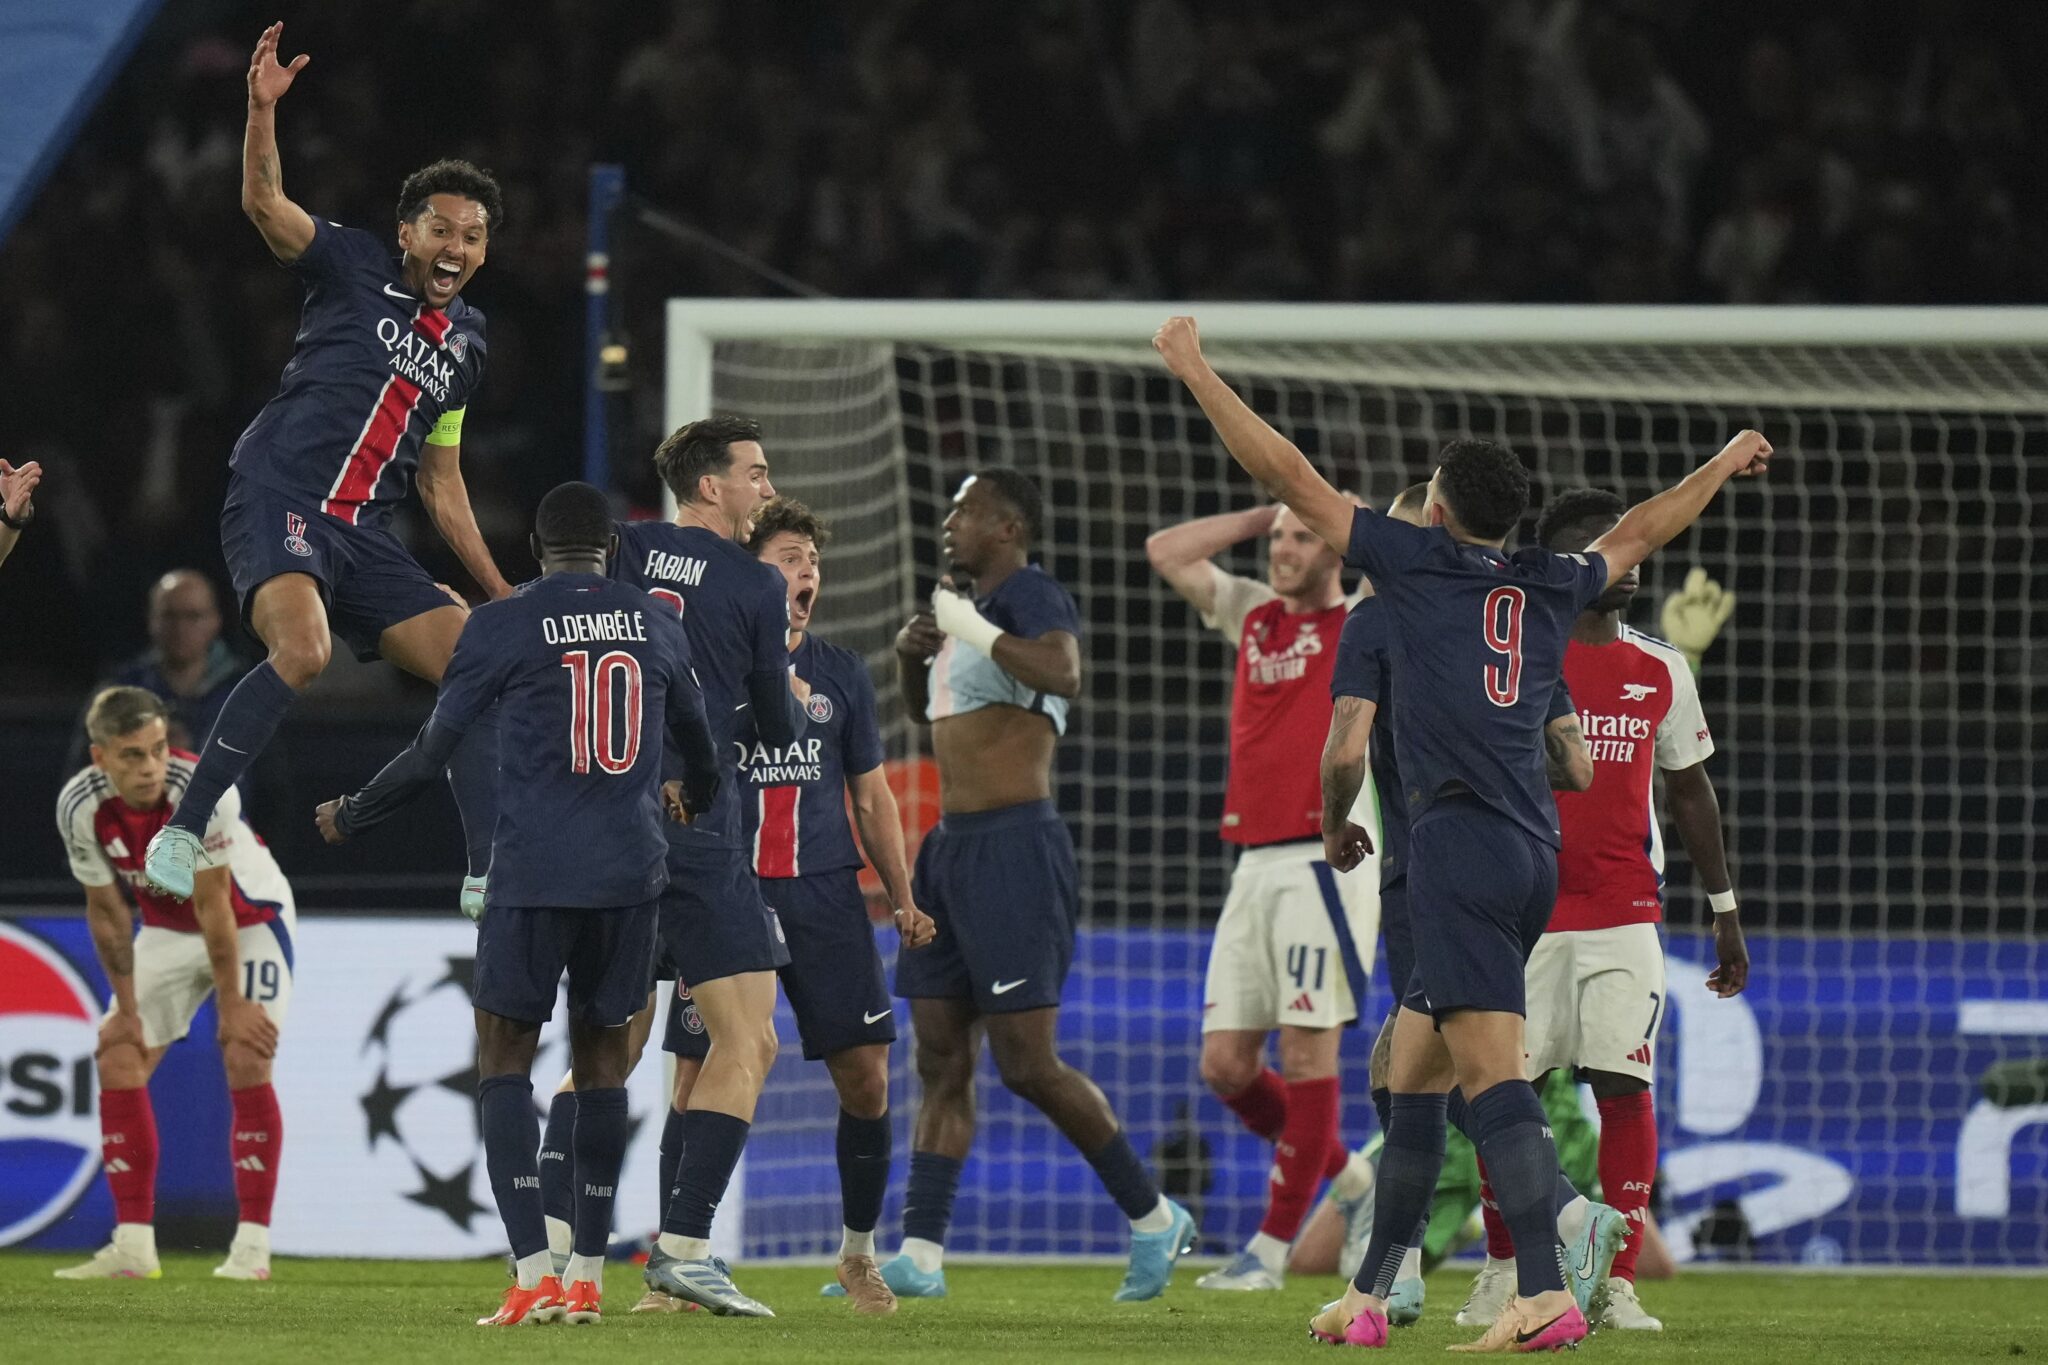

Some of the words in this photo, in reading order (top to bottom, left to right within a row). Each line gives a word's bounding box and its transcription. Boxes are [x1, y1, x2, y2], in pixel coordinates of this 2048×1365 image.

[377, 317, 454, 388] QATAR
[388, 354, 449, 402] AIRWAYS
[644, 550, 707, 586] FABIAN
[542, 610, 648, 645] O.DEMBÉLÉ
[1484, 585, 1525, 707] 9
[561, 650, 643, 775] 10
[749, 765, 821, 783] AIRWAYS
[243, 960, 279, 1001] 19
[1287, 945, 1327, 991] 41
[1644, 991, 1660, 1040] 7
[0, 1052, 92, 1118] SI
[514, 1176, 540, 1190] PARIS
[585, 1183, 613, 1198] PARIS
[1622, 1180, 1651, 1195] AFC
